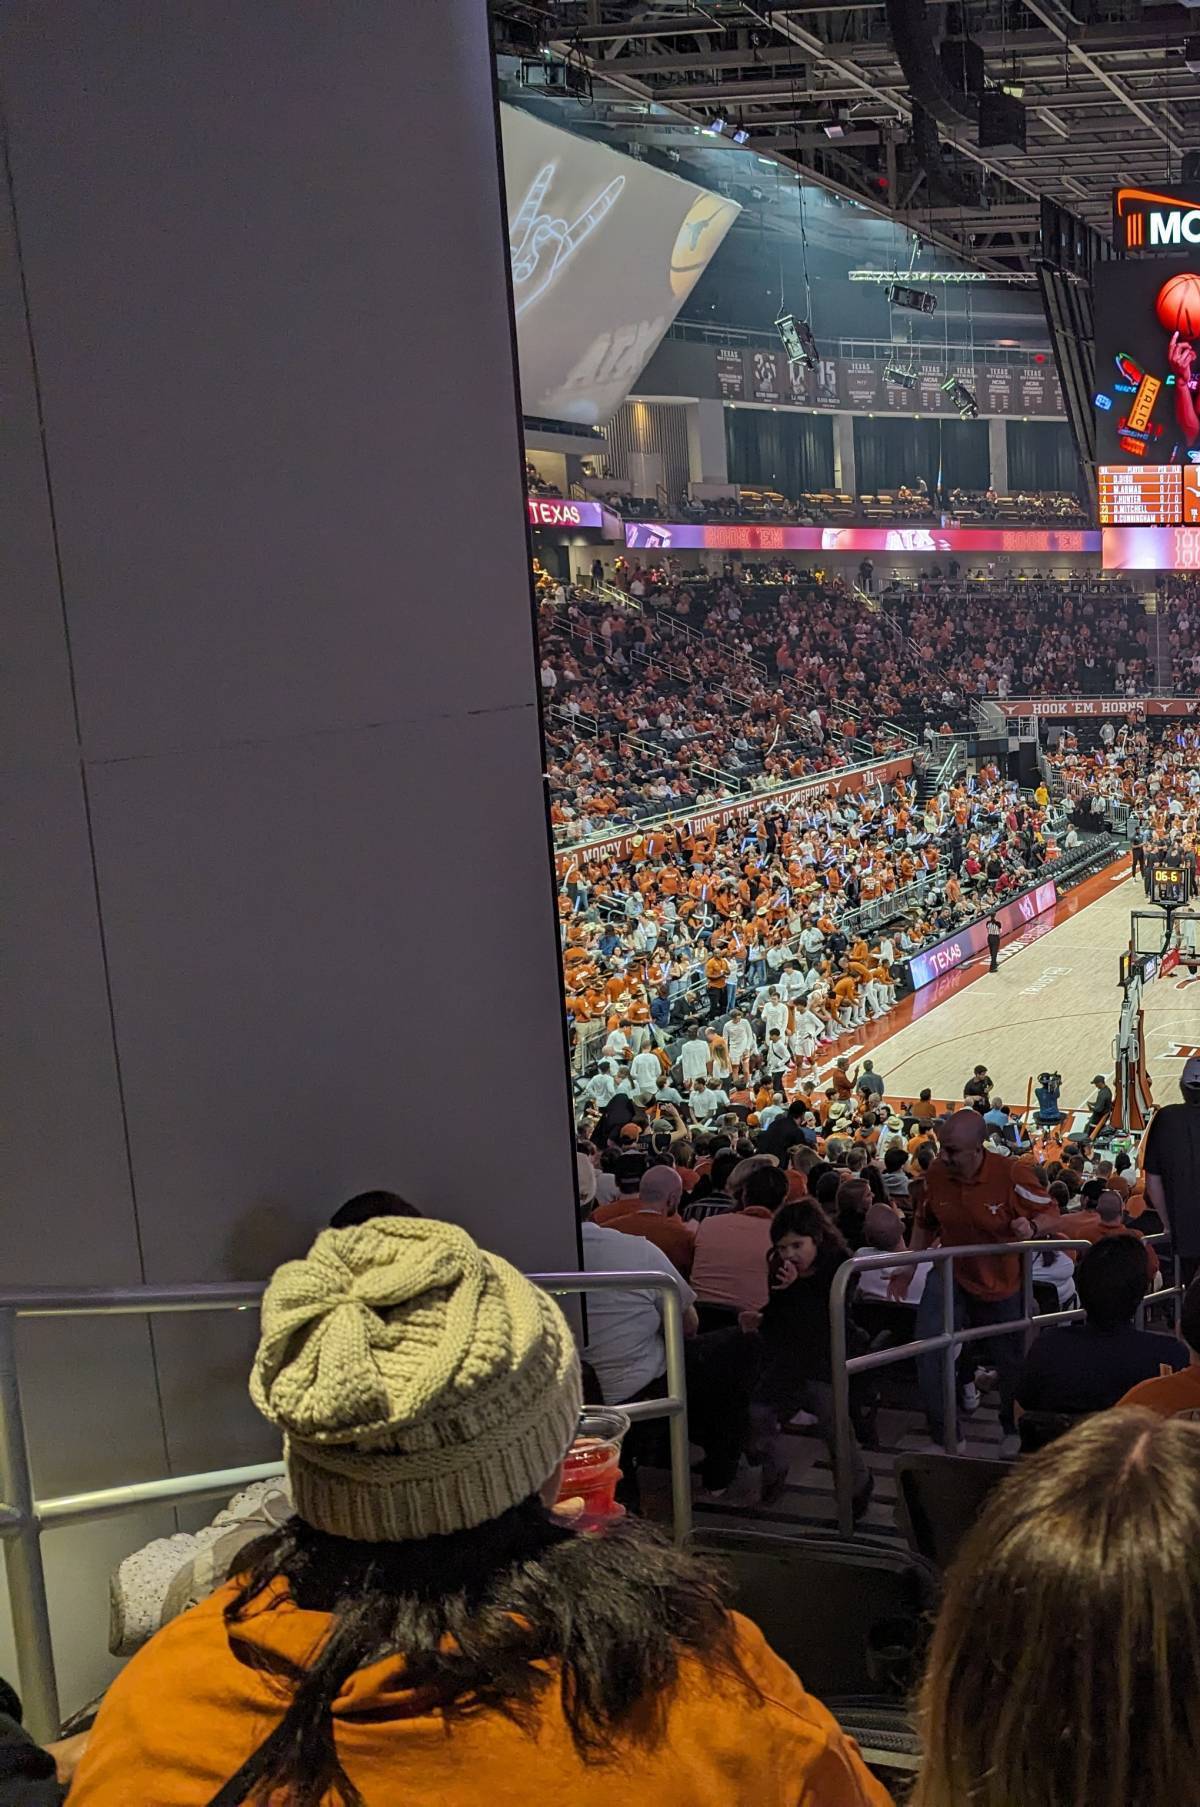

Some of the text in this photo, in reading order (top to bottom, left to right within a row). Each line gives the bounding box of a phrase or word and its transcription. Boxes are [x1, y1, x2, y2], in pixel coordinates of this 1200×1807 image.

[1136, 382, 1157, 426] ITALIC
[529, 502, 580, 524] TEXAS
[1032, 703, 1067, 713] HOOK
[1101, 702, 1144, 713] HORNS
[583, 840, 622, 863] MOODY
[930, 944, 962, 972] TEXAS
[1019, 967, 1062, 995] TRUIST
